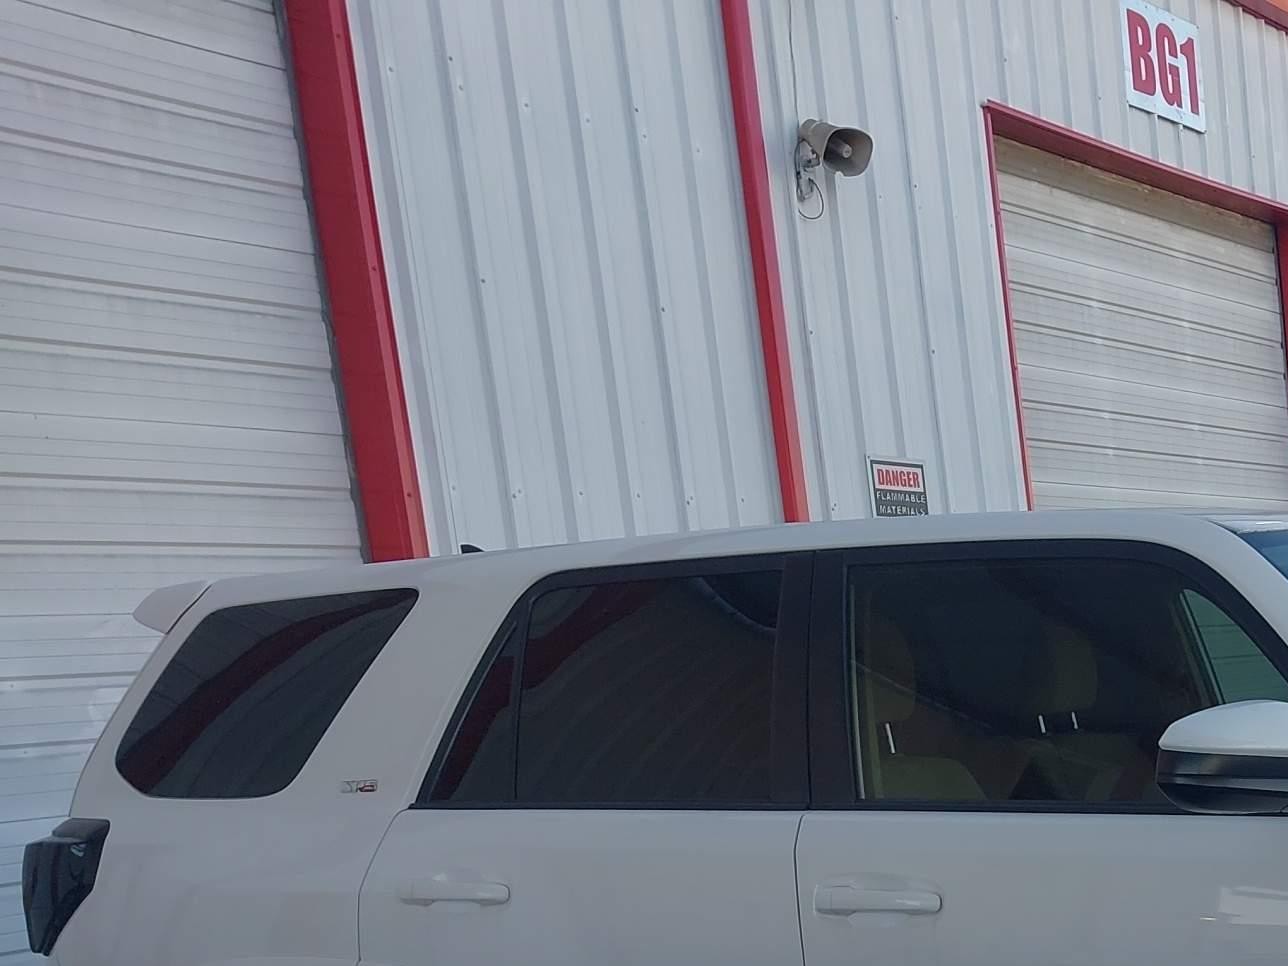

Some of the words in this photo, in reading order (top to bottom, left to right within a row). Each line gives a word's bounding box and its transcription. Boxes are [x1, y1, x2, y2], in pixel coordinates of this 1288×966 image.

[1126, 8, 1200, 116] BG1
[876, 468, 920, 489] DANGER
[876, 490, 926, 504] FLAMMABLE
[879, 504, 926, 517] MATERIALS
